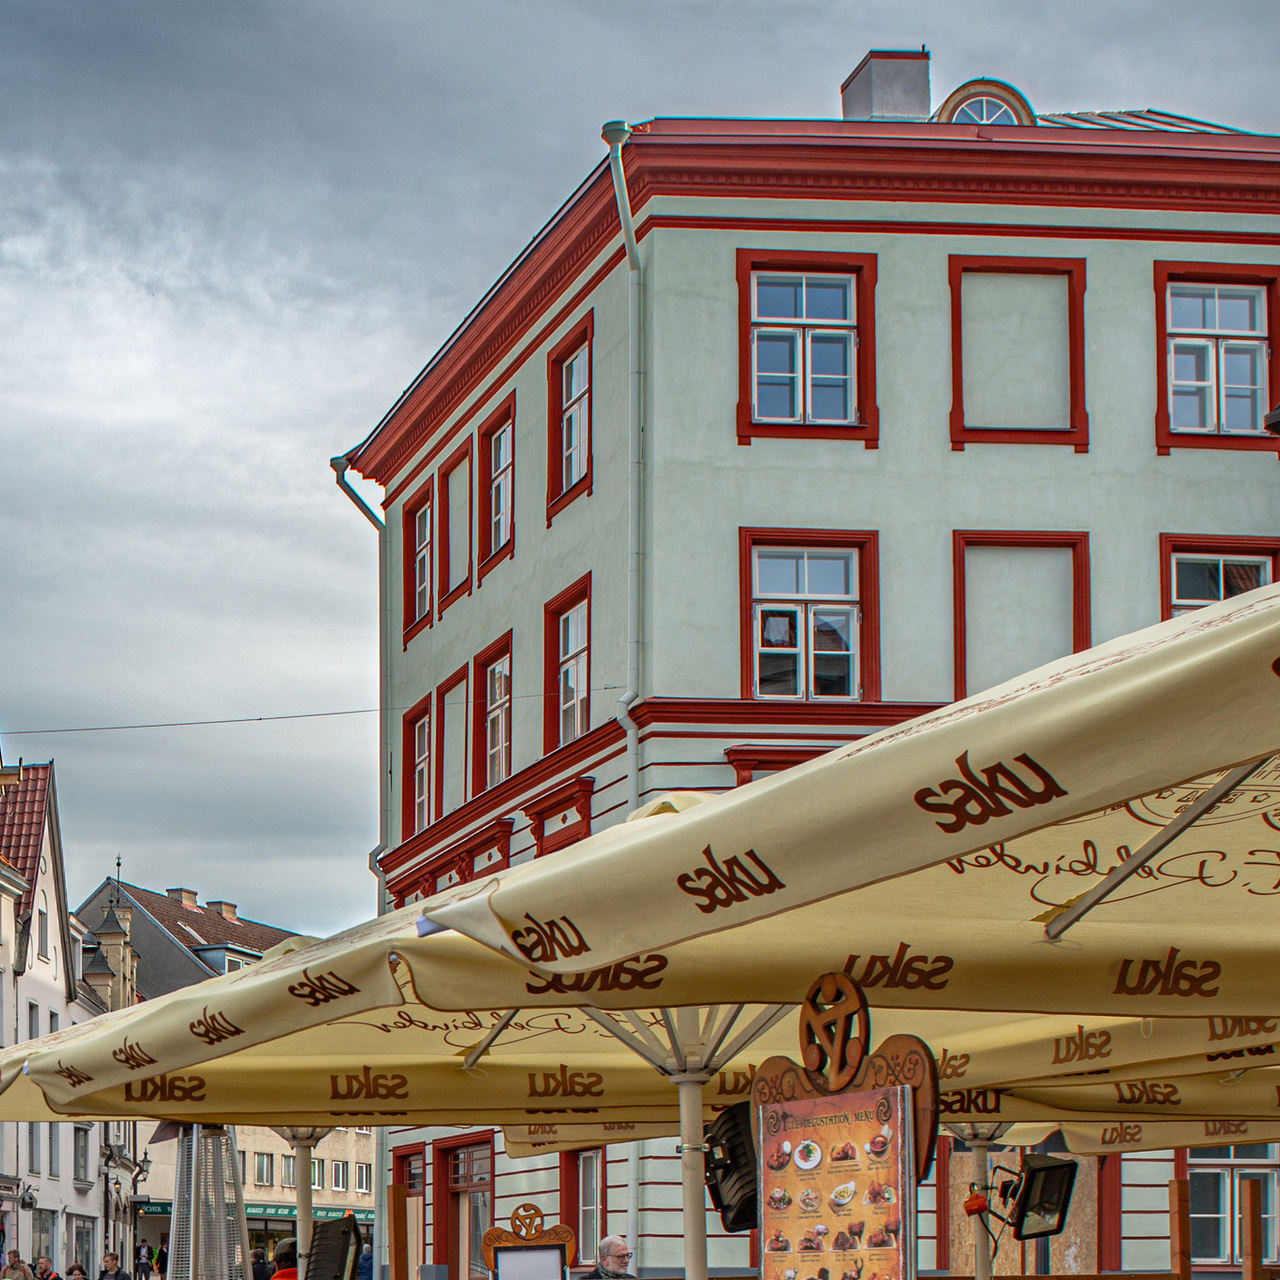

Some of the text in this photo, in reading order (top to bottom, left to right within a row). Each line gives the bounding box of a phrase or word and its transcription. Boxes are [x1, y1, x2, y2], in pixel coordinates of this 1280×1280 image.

[915, 750, 1068, 834] saku
[677, 845, 786, 914] saku
[511, 912, 592, 963] saku
[288, 967, 361, 1007] saku
[189, 1004, 246, 1045] saku
[112, 1035, 158, 1070] saku
[54, 1059, 95, 1088] saku
[854, 1110, 875, 1123] MENU
[939, 1089, 1002, 1114] saku
